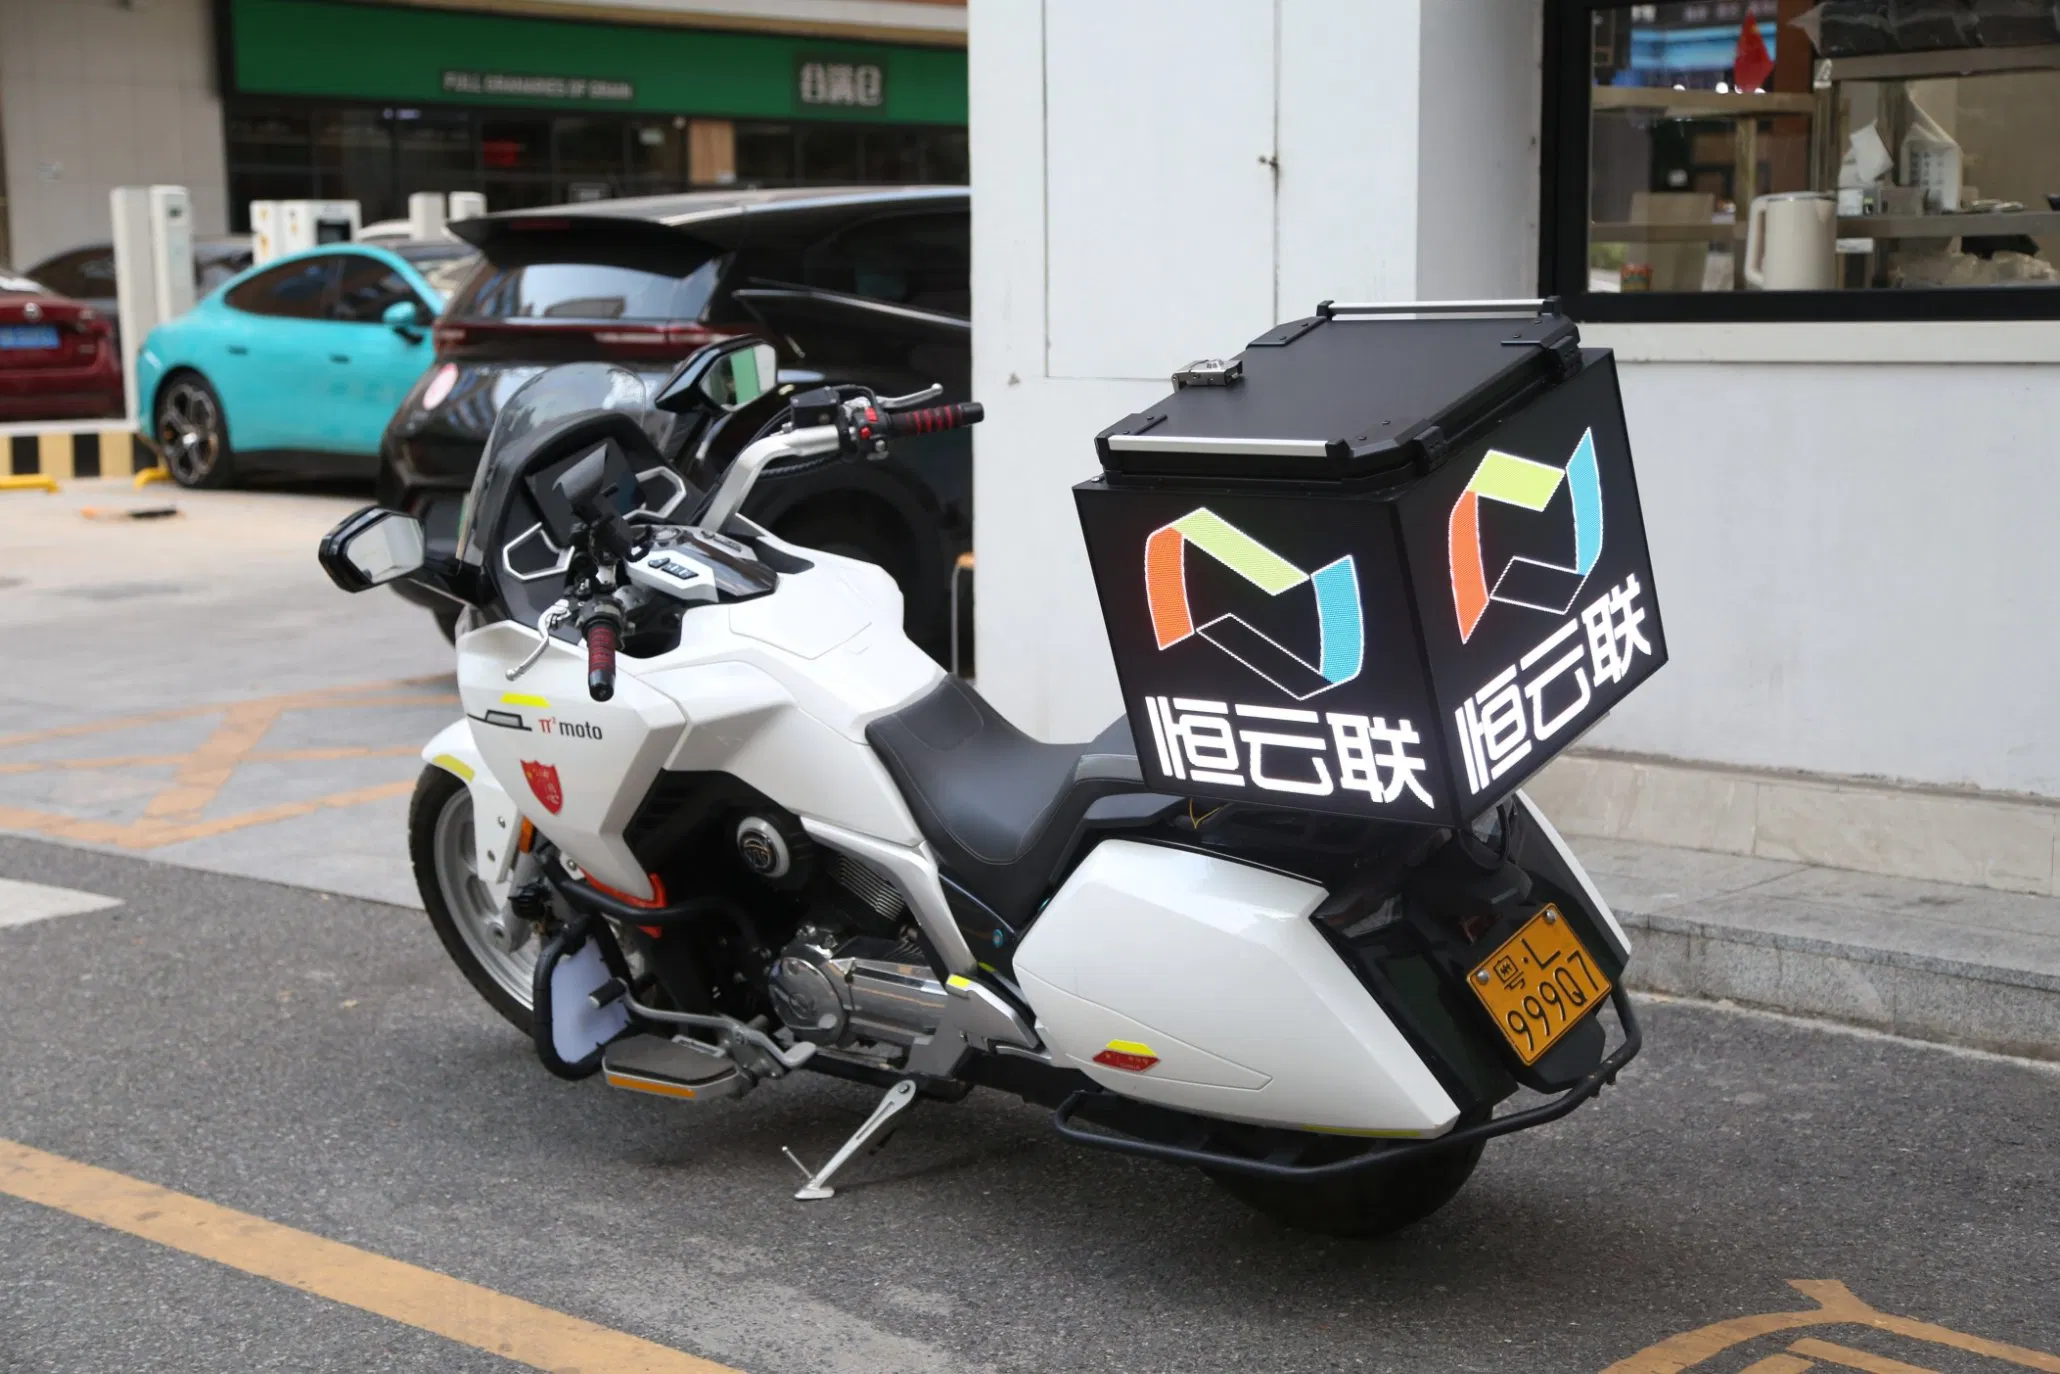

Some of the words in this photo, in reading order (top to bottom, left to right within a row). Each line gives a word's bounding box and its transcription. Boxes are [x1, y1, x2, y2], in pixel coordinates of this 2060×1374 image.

[558, 721, 603, 740] moto
[1455, 573, 1652, 796] 恒云联
[1145, 696, 1435, 809] 恒云联
